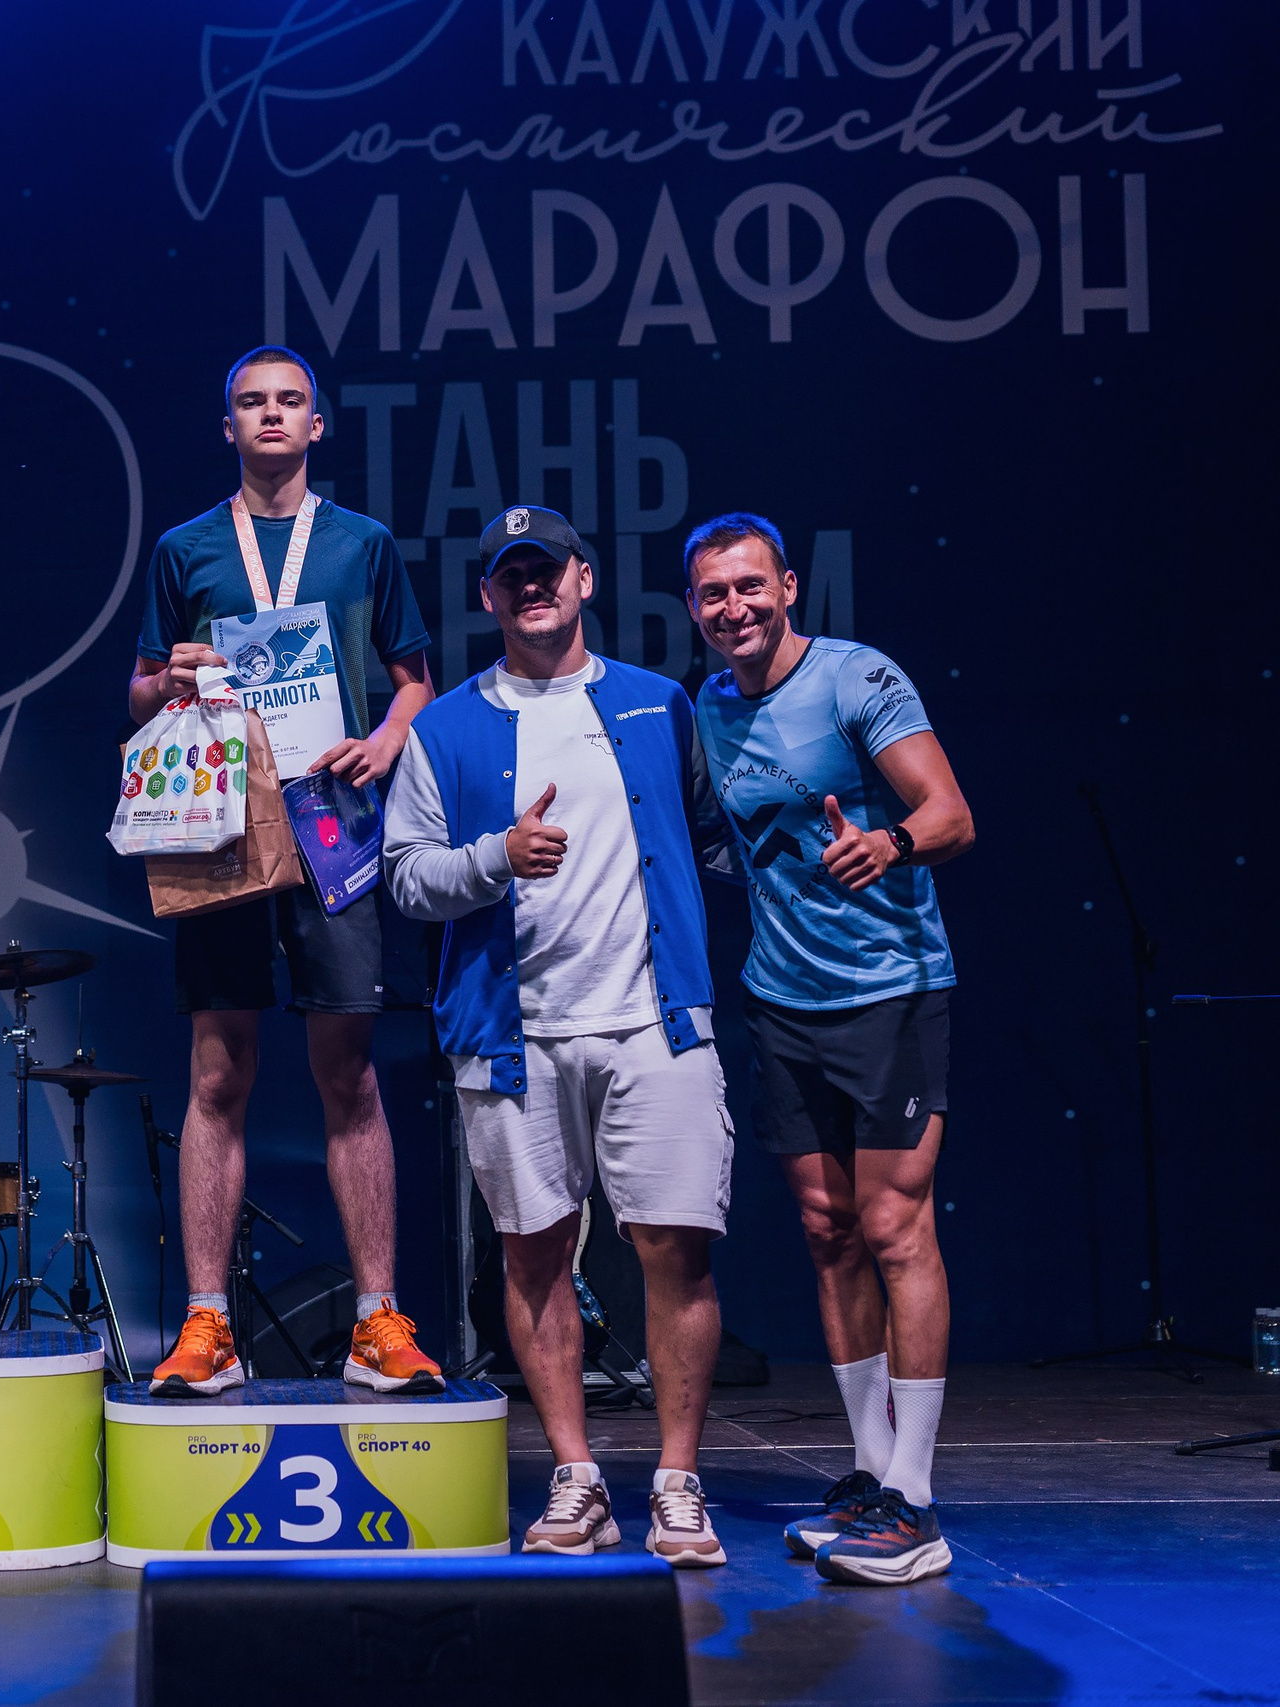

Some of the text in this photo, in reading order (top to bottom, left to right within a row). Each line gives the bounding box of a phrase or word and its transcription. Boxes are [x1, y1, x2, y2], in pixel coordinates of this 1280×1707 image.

[262, 174, 1152, 357] МАРАФОН
[317, 378, 689, 537] ТАНЬ
[276, 541, 306, 609] 2012-201
[280, 618, 322, 632] МАРАФОН
[242, 682, 321, 710] ГРАМОТА
[881, 688, 908, 702] ГОНКА
[879, 694, 917, 715] ЛЕГКОВА
[262, 713, 288, 722] ЖДАЕТСЯ
[719, 764, 755, 802] МАНДА
[133, 810, 169, 818] копицентр
[213, 864, 240, 876] АРХБУМ
[348, 861, 379, 889] оритмика
[188, 1435, 207, 1443] PRO
[358, 1433, 377, 1441] PRO
[188, 1443, 261, 1455] СПОРТ 40
[358, 1440, 431, 1452] СПОРТ 40
[280, 1454, 342, 1543] 3
